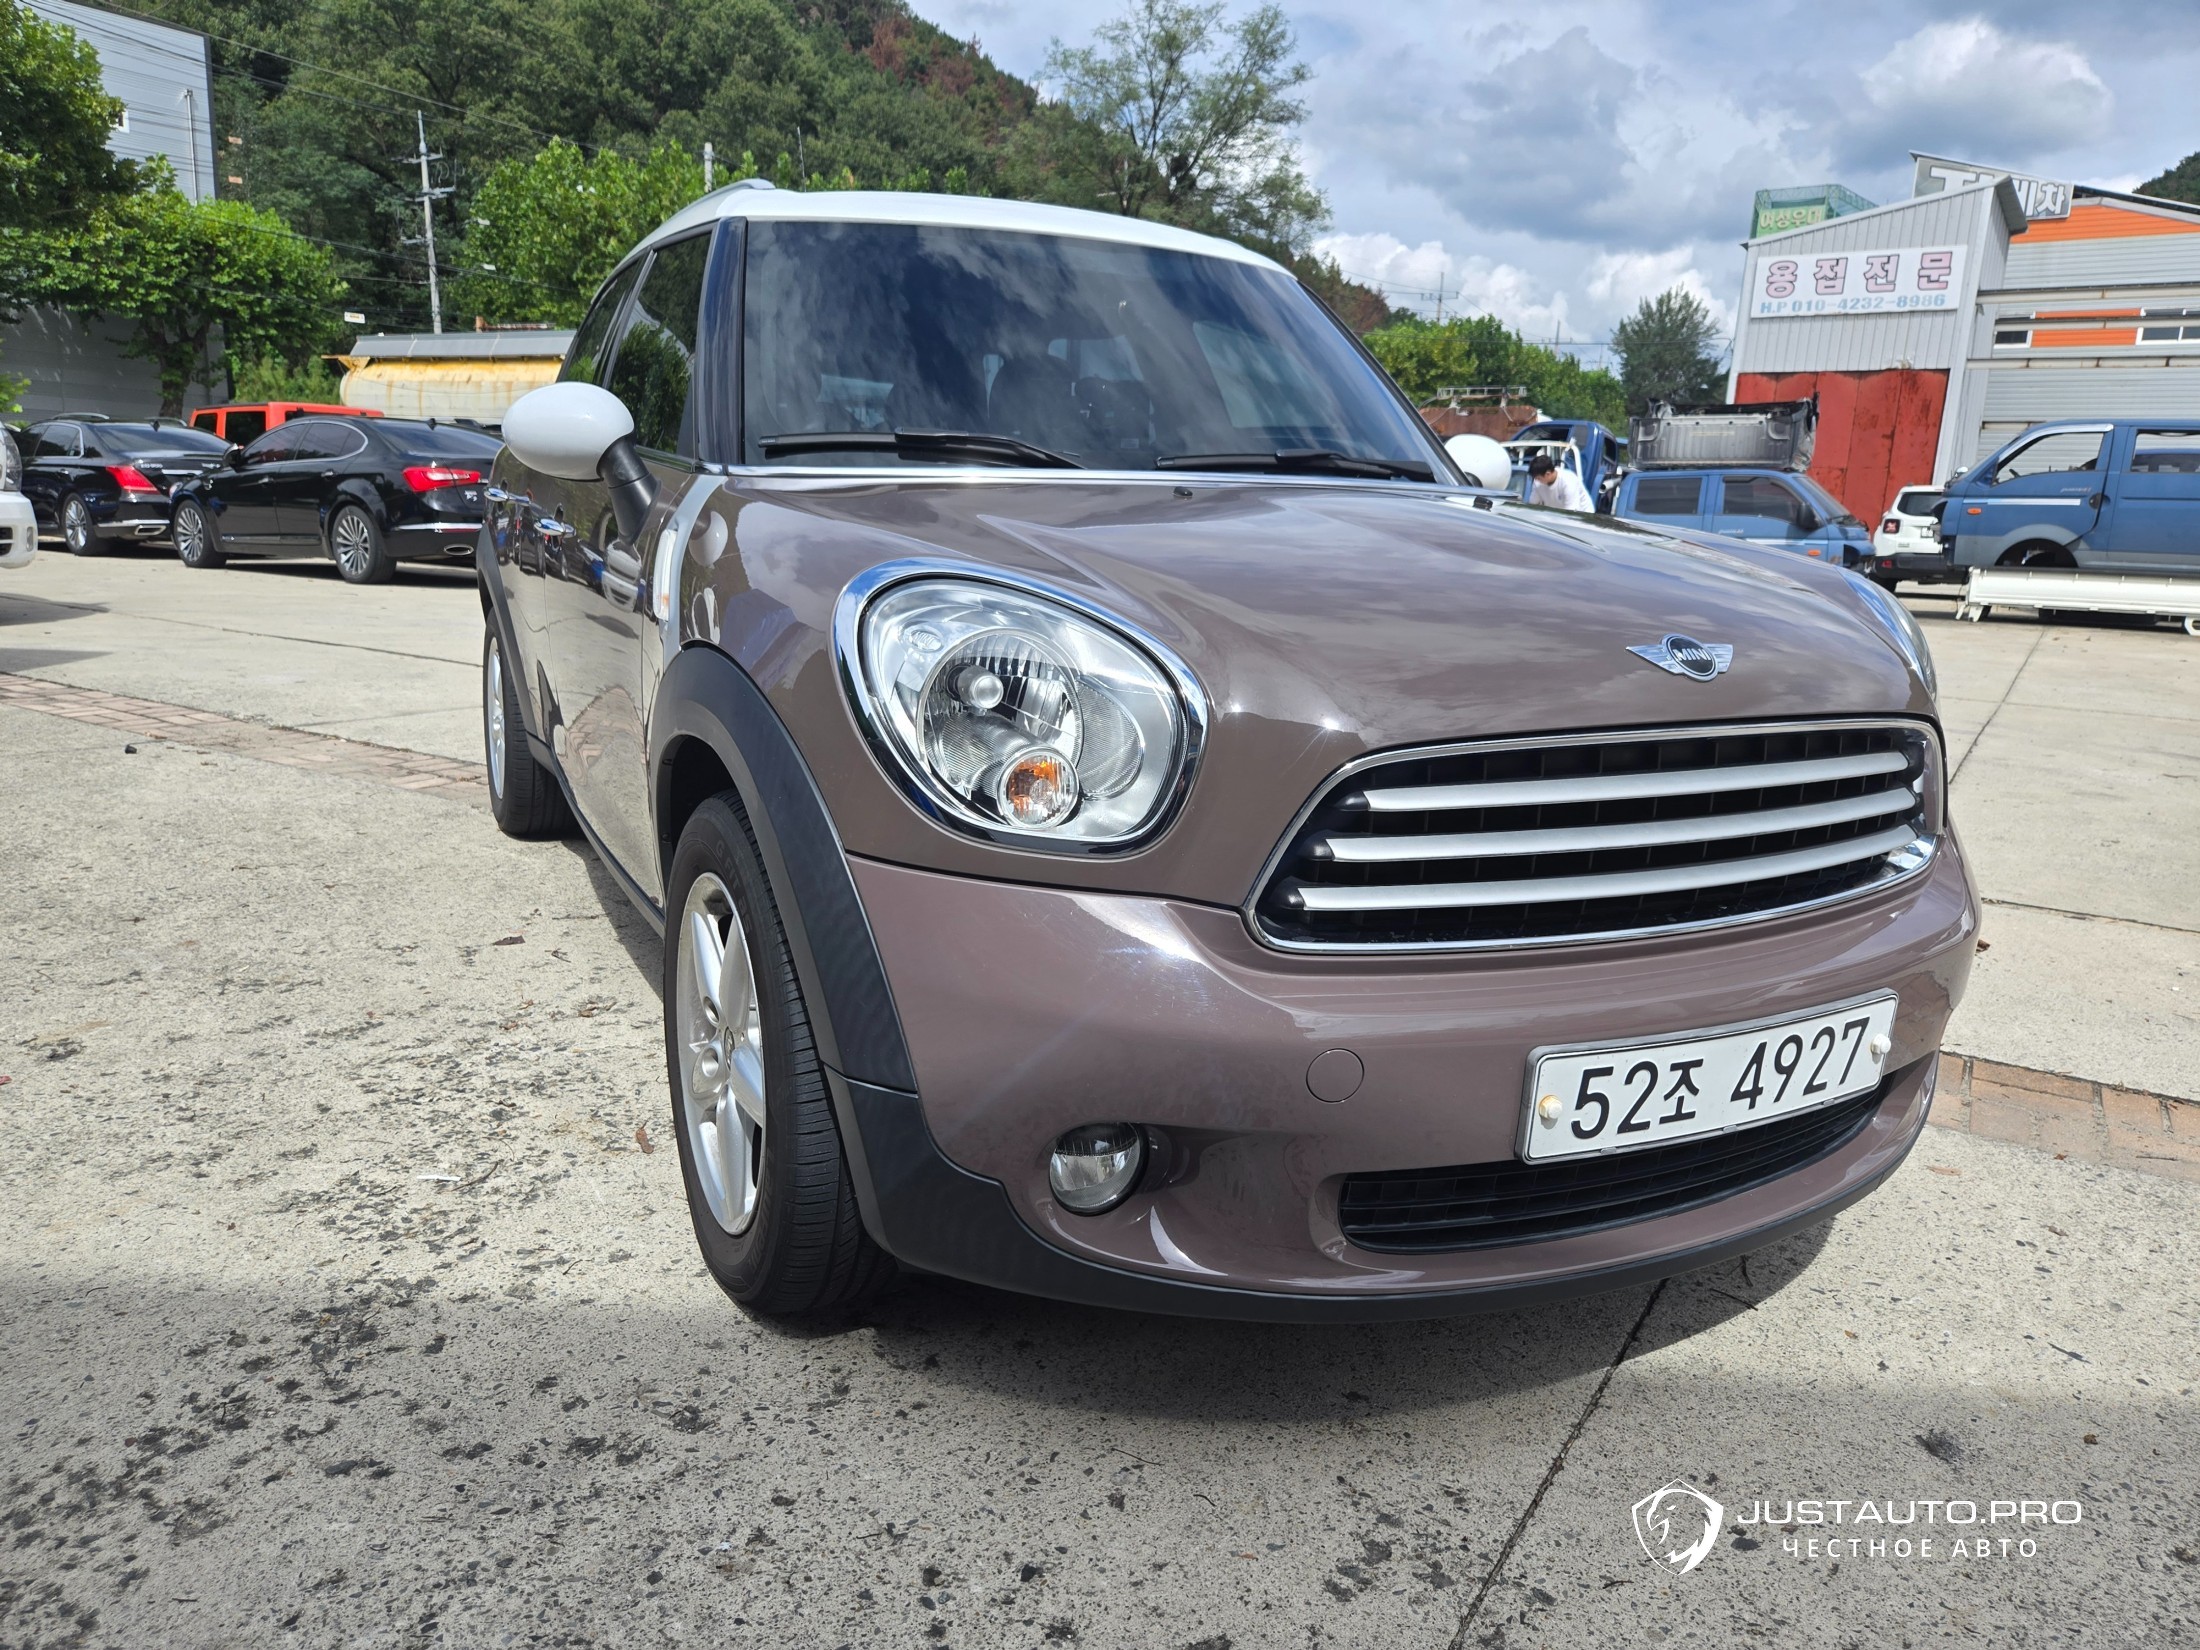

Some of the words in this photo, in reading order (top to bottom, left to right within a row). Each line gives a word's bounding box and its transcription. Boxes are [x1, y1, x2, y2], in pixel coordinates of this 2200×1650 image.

[1765, 251, 1952, 298] 용접전문
[1760, 301, 1788, 314] H.P
[1672, 647, 1712, 661] MINI
[1569, 1057, 1705, 1140] 52조
[1729, 1016, 1872, 1111] 4927
